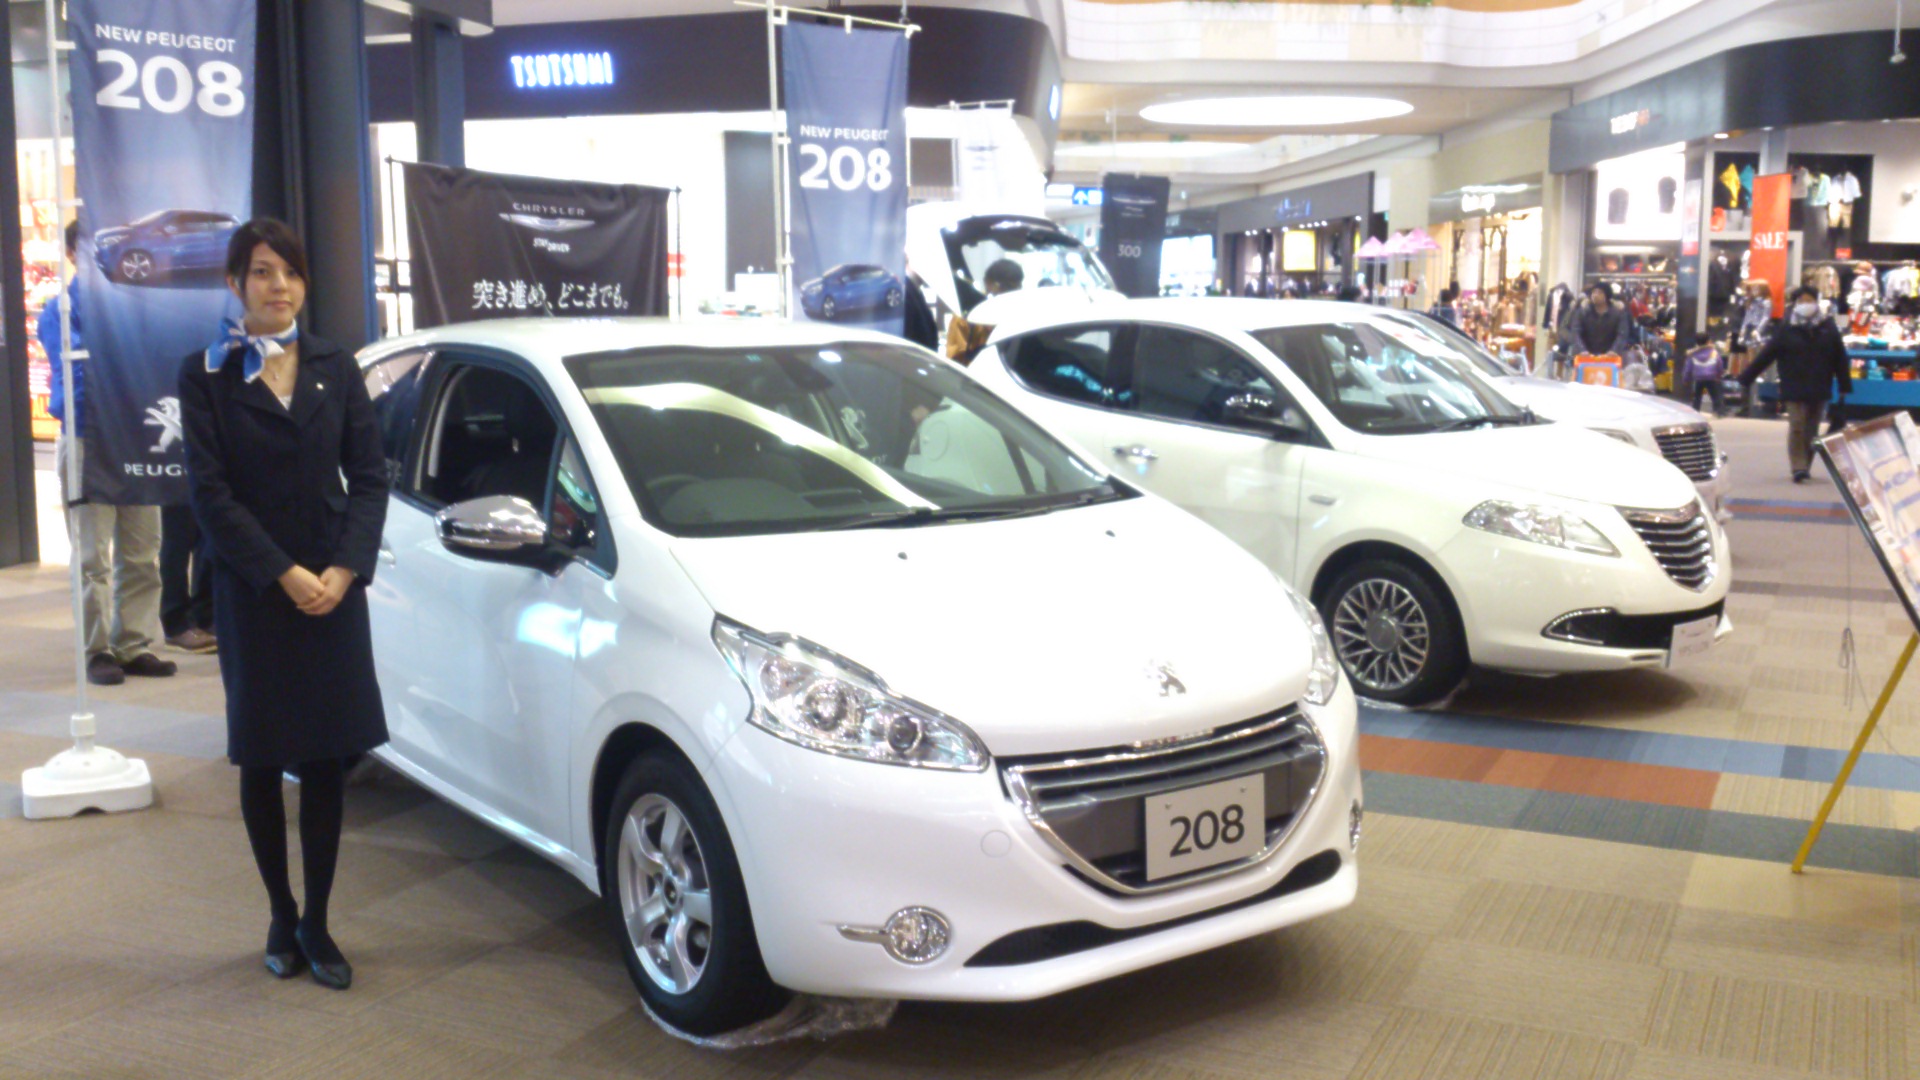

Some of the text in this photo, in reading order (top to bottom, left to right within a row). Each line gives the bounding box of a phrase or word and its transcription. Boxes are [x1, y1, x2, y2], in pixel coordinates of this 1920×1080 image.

[95, 23, 236, 52] NEW PEUGEOT
[96, 48, 246, 117] 208
[510, 51, 614, 88] TSUTSUMI
[800, 124, 832, 139] NEW
[799, 143, 892, 192] 208
[512, 202, 586, 216] CHRYSLER
[1117, 244, 1142, 258] 300
[1753, 231, 1785, 250] SALE
[471, 279, 630, 310] 突き進め、どこまでも。
[124, 463, 187, 476] PEUG
[1169, 803, 1245, 858] 208
